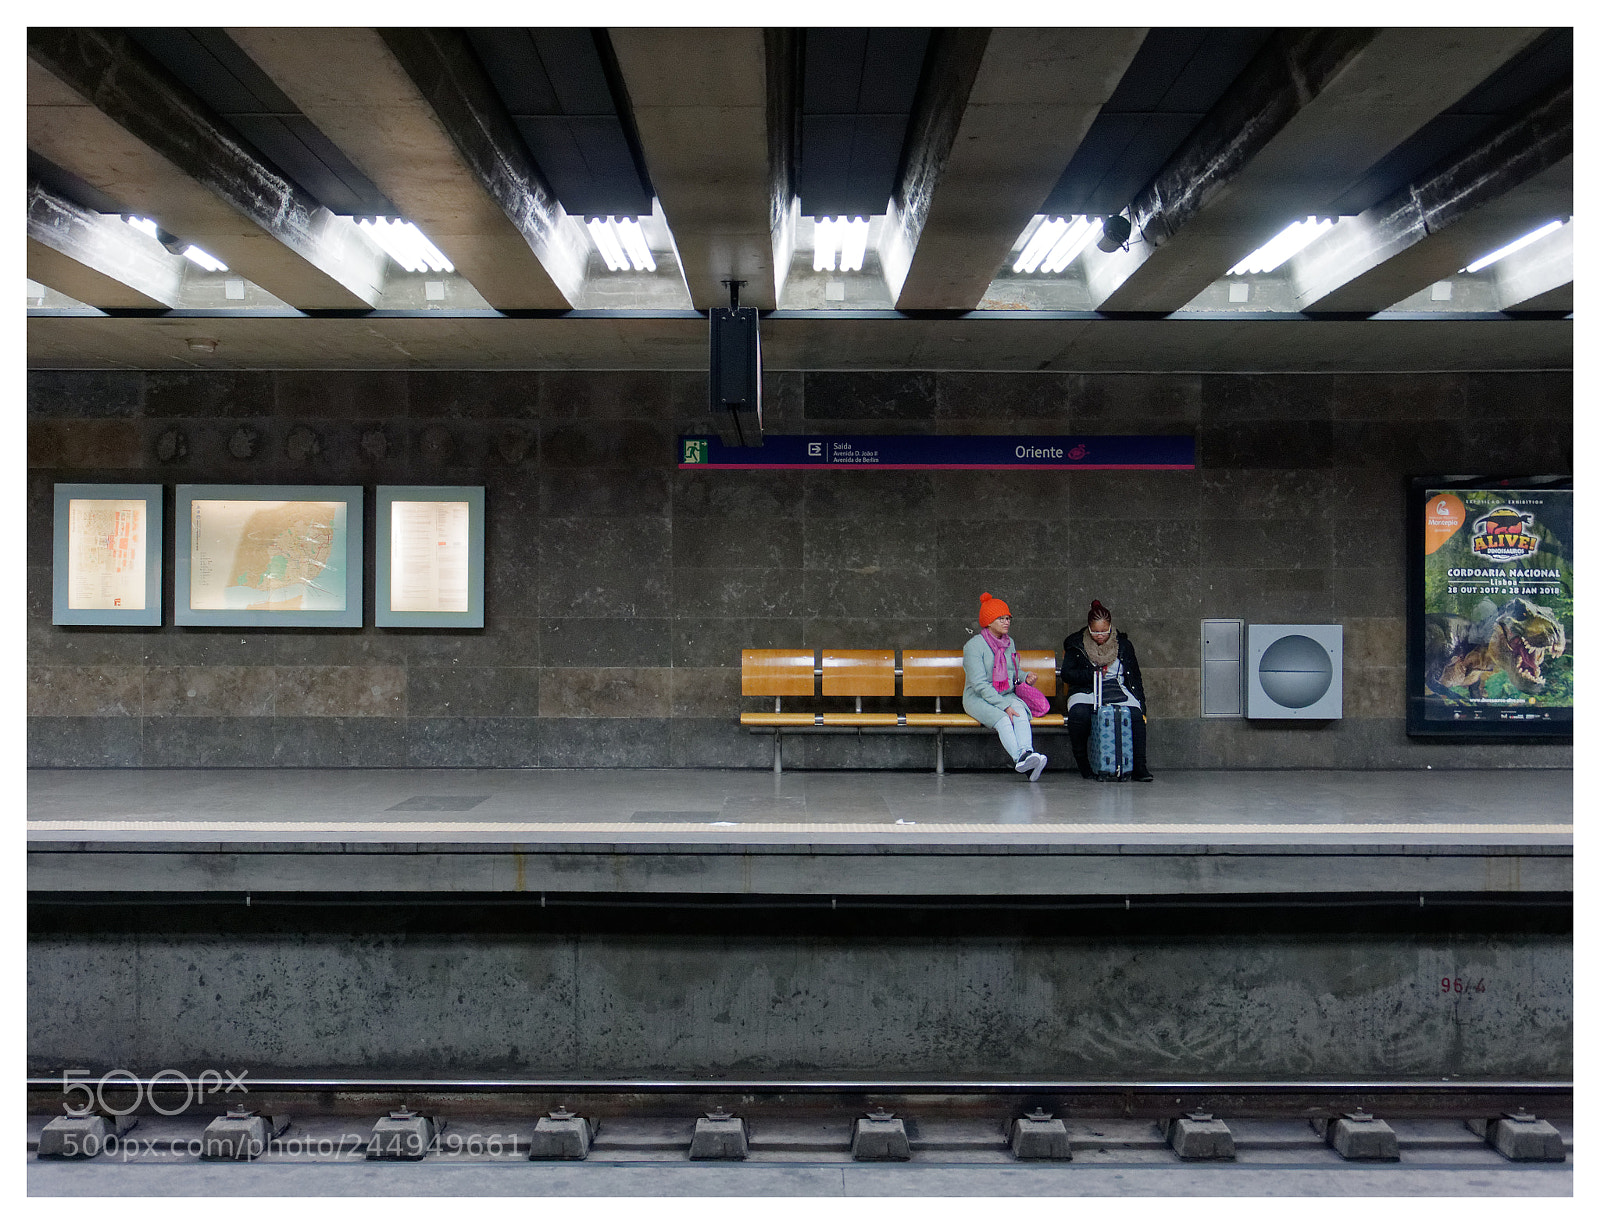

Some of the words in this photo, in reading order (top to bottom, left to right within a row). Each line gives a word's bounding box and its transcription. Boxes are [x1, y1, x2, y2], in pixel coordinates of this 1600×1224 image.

[1015, 445, 1064, 459] Oriente
[1428, 519, 1459, 527] Montepio
[1474, 534, 1537, 551] ALIVE!
[1447, 569, 1506, 577] CORDOARIA
[1509, 569, 1560, 577] NACIONAL
[1460, 586, 1478, 594] OUT
[1479, 586, 1499, 594] 2017
[1509, 586, 1519, 594] 28
[1521, 587, 1538, 595] JAN
[1539, 587, 1560, 595] 2018
[1441, 977, 1486, 993] 96/4
